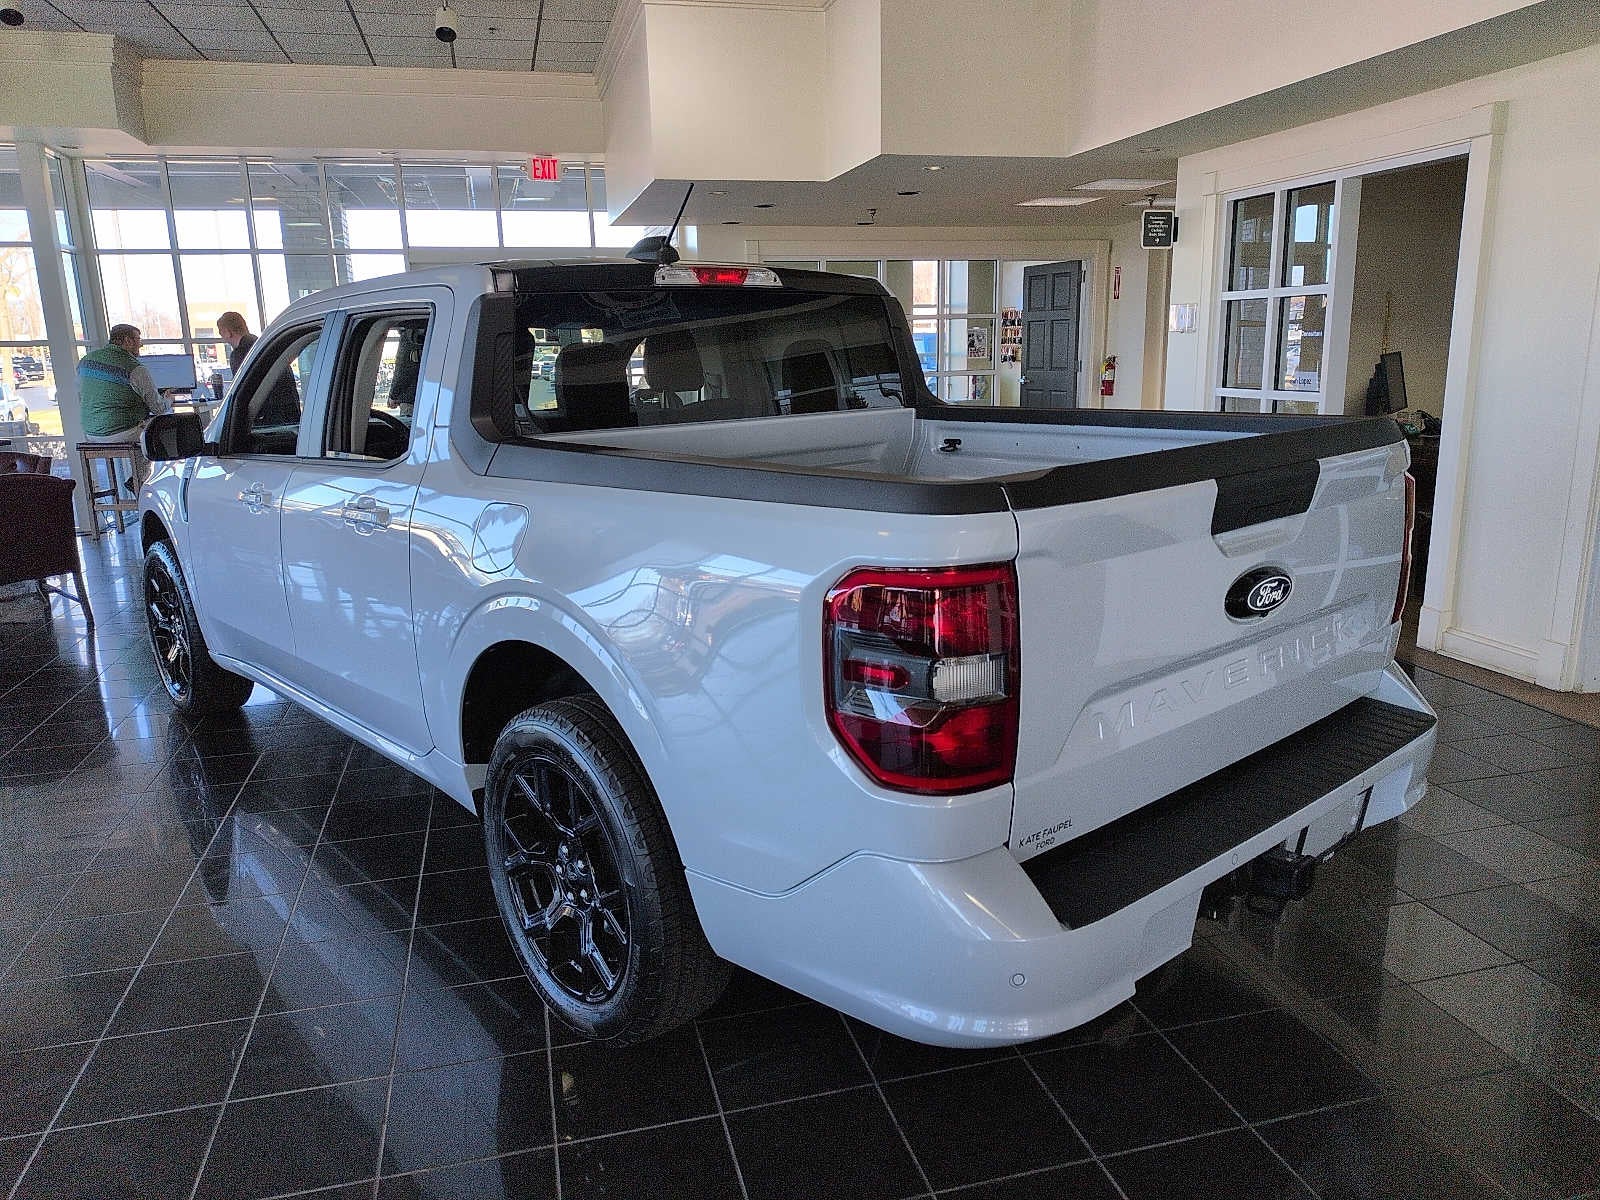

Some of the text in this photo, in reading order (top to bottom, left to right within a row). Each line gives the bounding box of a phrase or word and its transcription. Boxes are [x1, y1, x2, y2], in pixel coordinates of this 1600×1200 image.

[532, 159, 558, 179] EXIT
[1299, 377, 1312, 387] Lopez
[1256, 581, 1285, 607] Ford
[1093, 612, 1371, 742] MAVERICK
[1017, 819, 1073, 848] KATE FAUPEL
[1035, 837, 1056, 850] FORD
